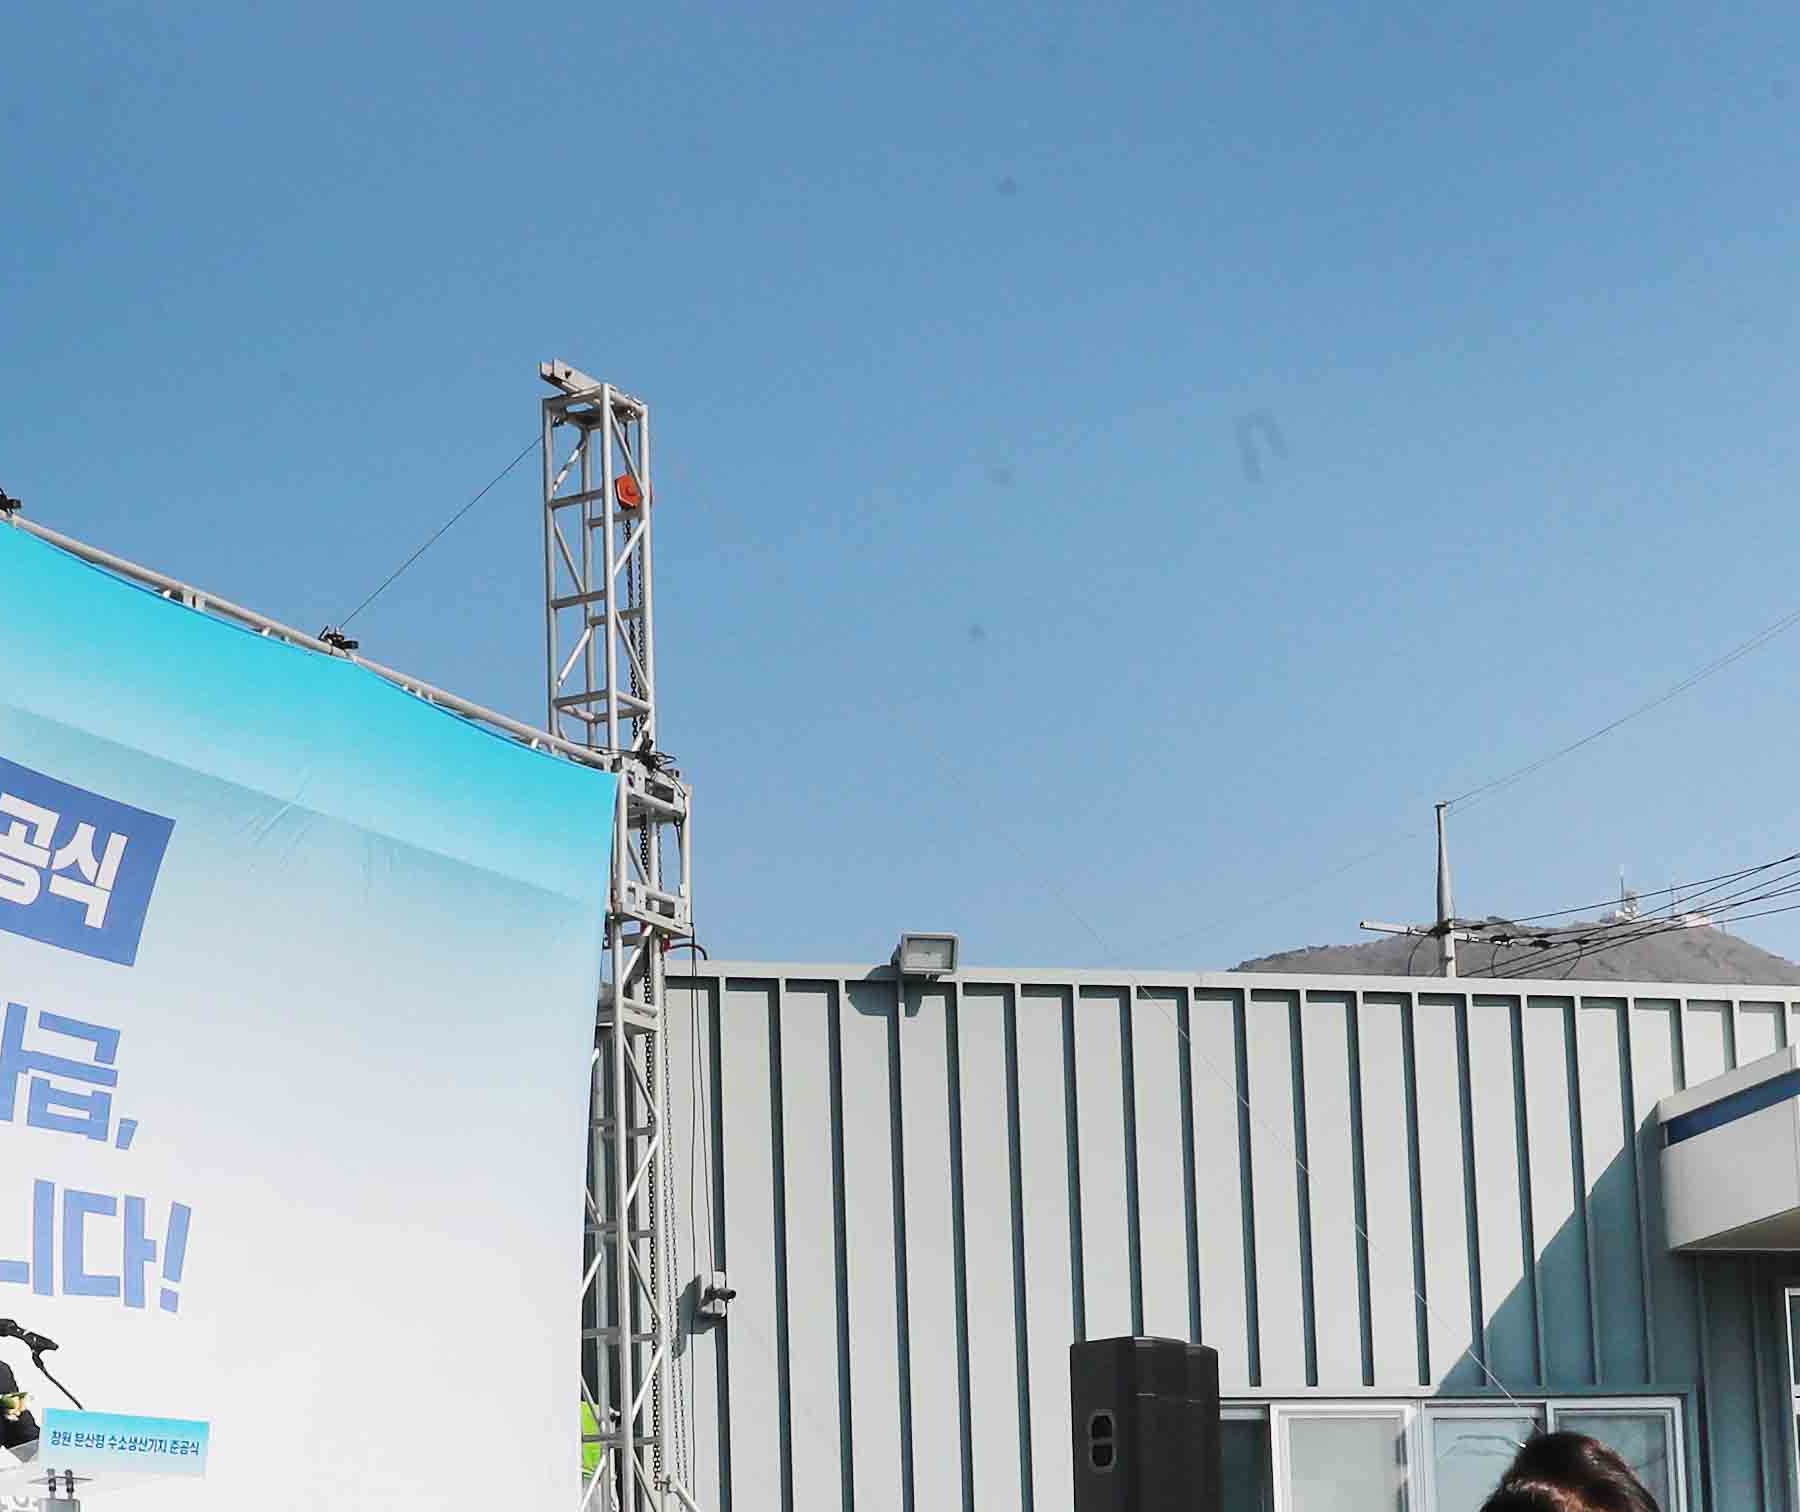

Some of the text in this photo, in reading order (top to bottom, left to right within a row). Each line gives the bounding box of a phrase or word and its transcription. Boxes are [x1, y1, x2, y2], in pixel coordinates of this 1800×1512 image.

[50, 1430, 200, 1456] 창원 분산형 수소생산기지 준공식
